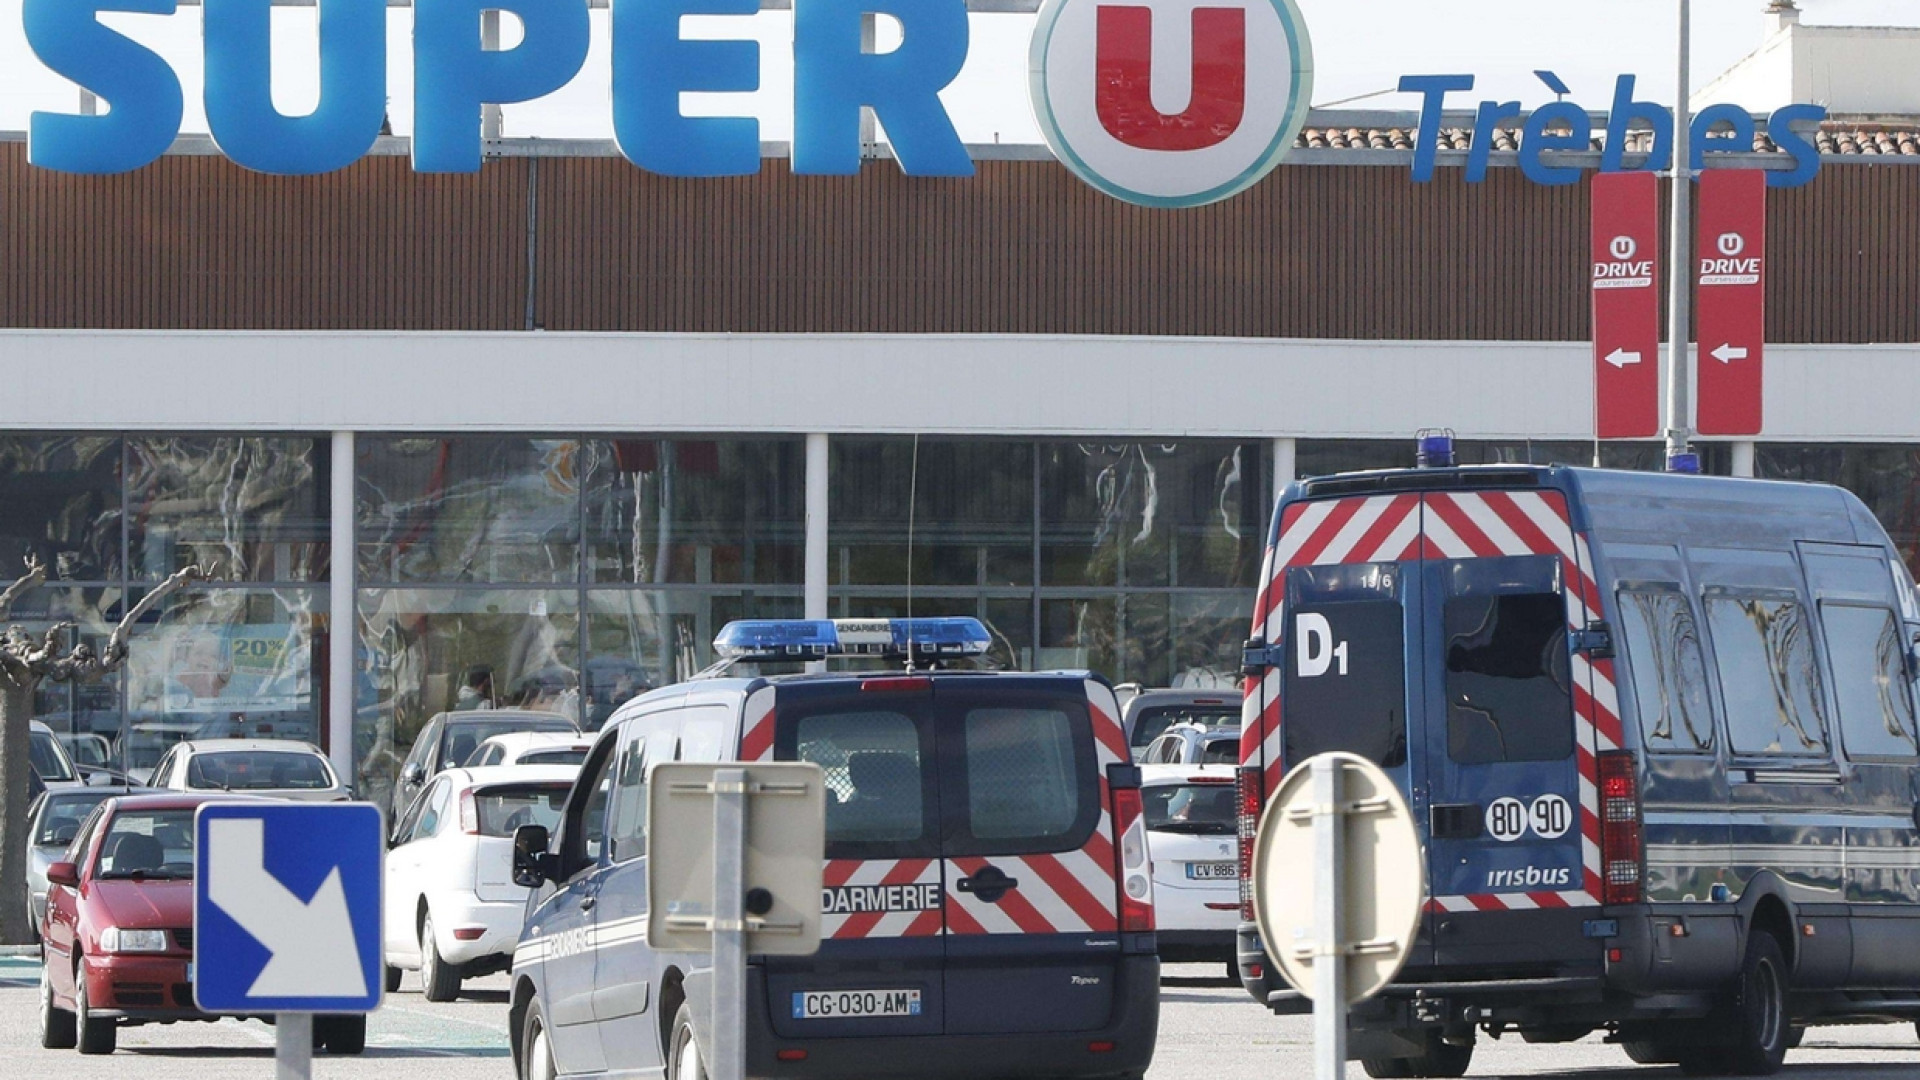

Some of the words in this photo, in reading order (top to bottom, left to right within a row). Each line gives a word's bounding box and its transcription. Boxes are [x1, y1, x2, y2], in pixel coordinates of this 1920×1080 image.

[23, 0, 976, 178] SUPER
[1095, 5, 1245, 151] U
[1397, 70, 1826, 187] Trèbes
[1593, 261, 1654, 278] DRIVE
[1700, 258, 1761, 274] DRIVE
[836, 623, 891, 633] GENDARMERIE
[234, 639, 283, 657] 20%
[1491, 802, 1521, 836] 80
[1536, 800, 1566, 833] 90
[807, 992, 908, 1015] CG-030-AM
